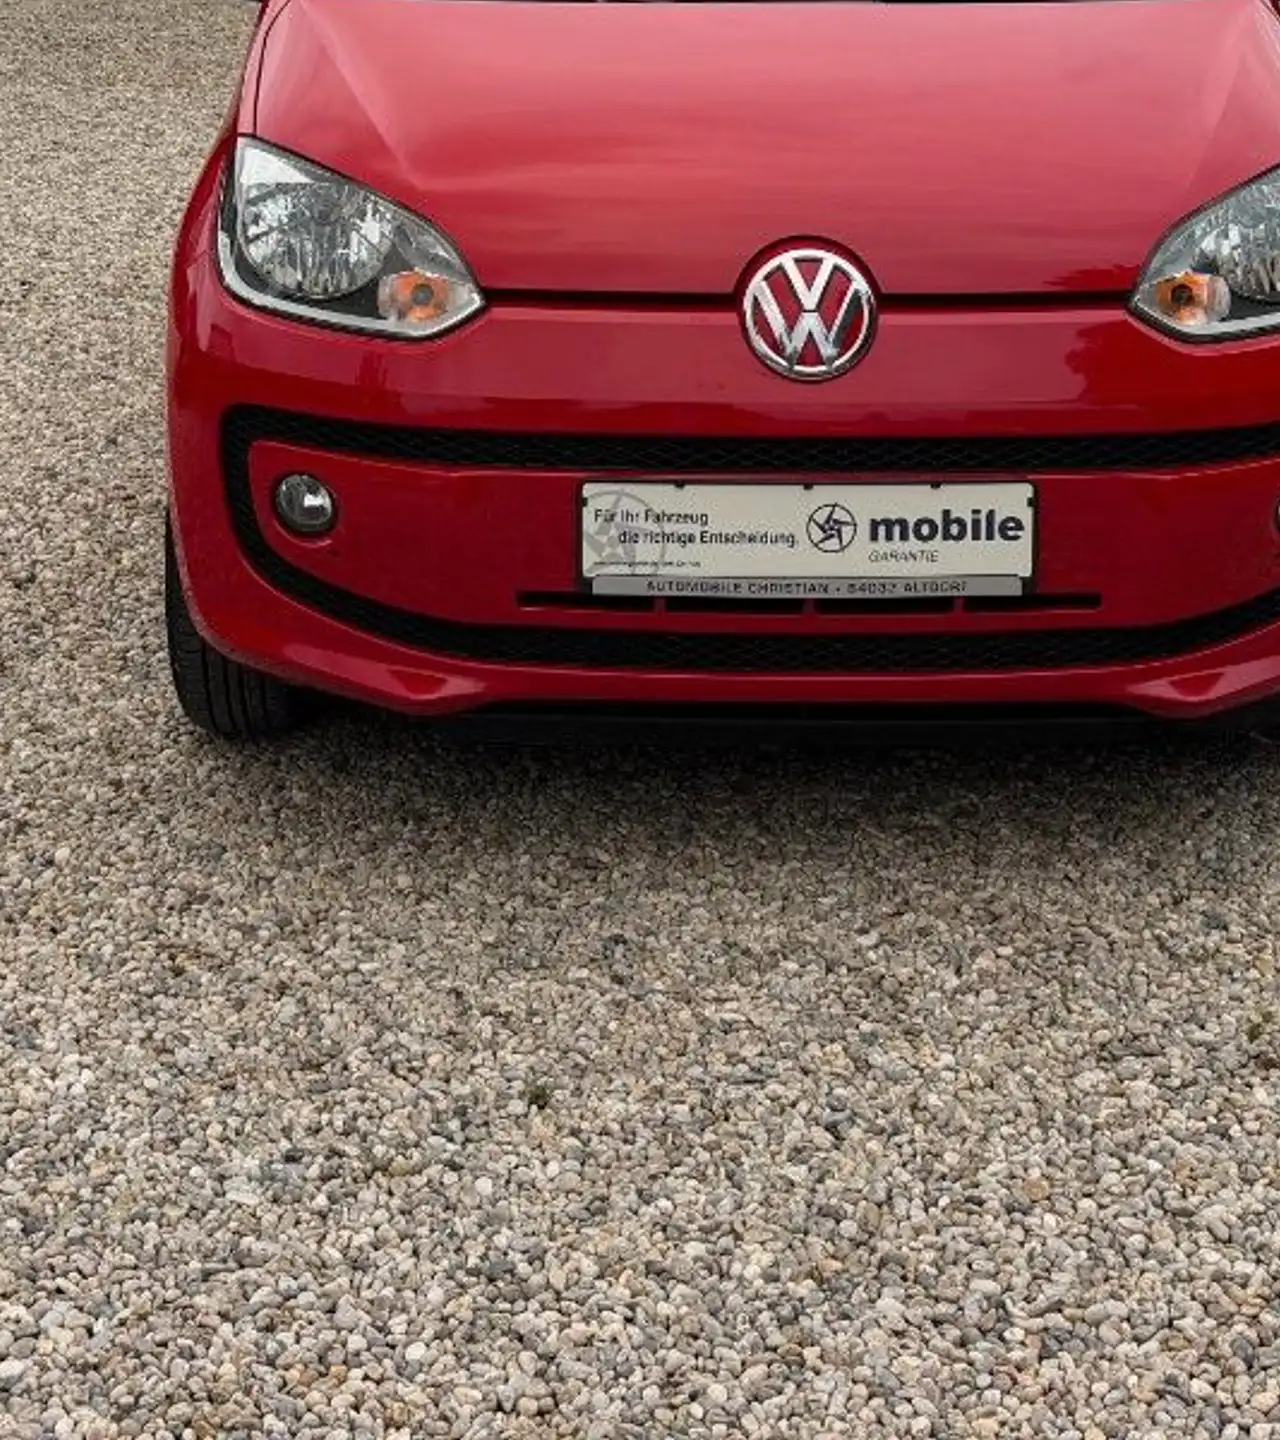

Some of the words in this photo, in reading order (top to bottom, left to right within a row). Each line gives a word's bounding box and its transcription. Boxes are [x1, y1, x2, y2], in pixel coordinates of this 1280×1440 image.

[594, 509, 617, 523] Für
[621, 510, 640, 523] Ihr
[644, 510, 709, 527] Fahrzeug
[869, 508, 1026, 543] mobile
[618, 529, 639, 544] die
[644, 530, 696, 547] richtige
[700, 530, 800, 548] Entscheidung.
[868, 549, 940, 564] GARANTIE
[646, 580, 743, 594] AUTOMOBILE
[747, 581, 830, 595] CHRISTIAN
